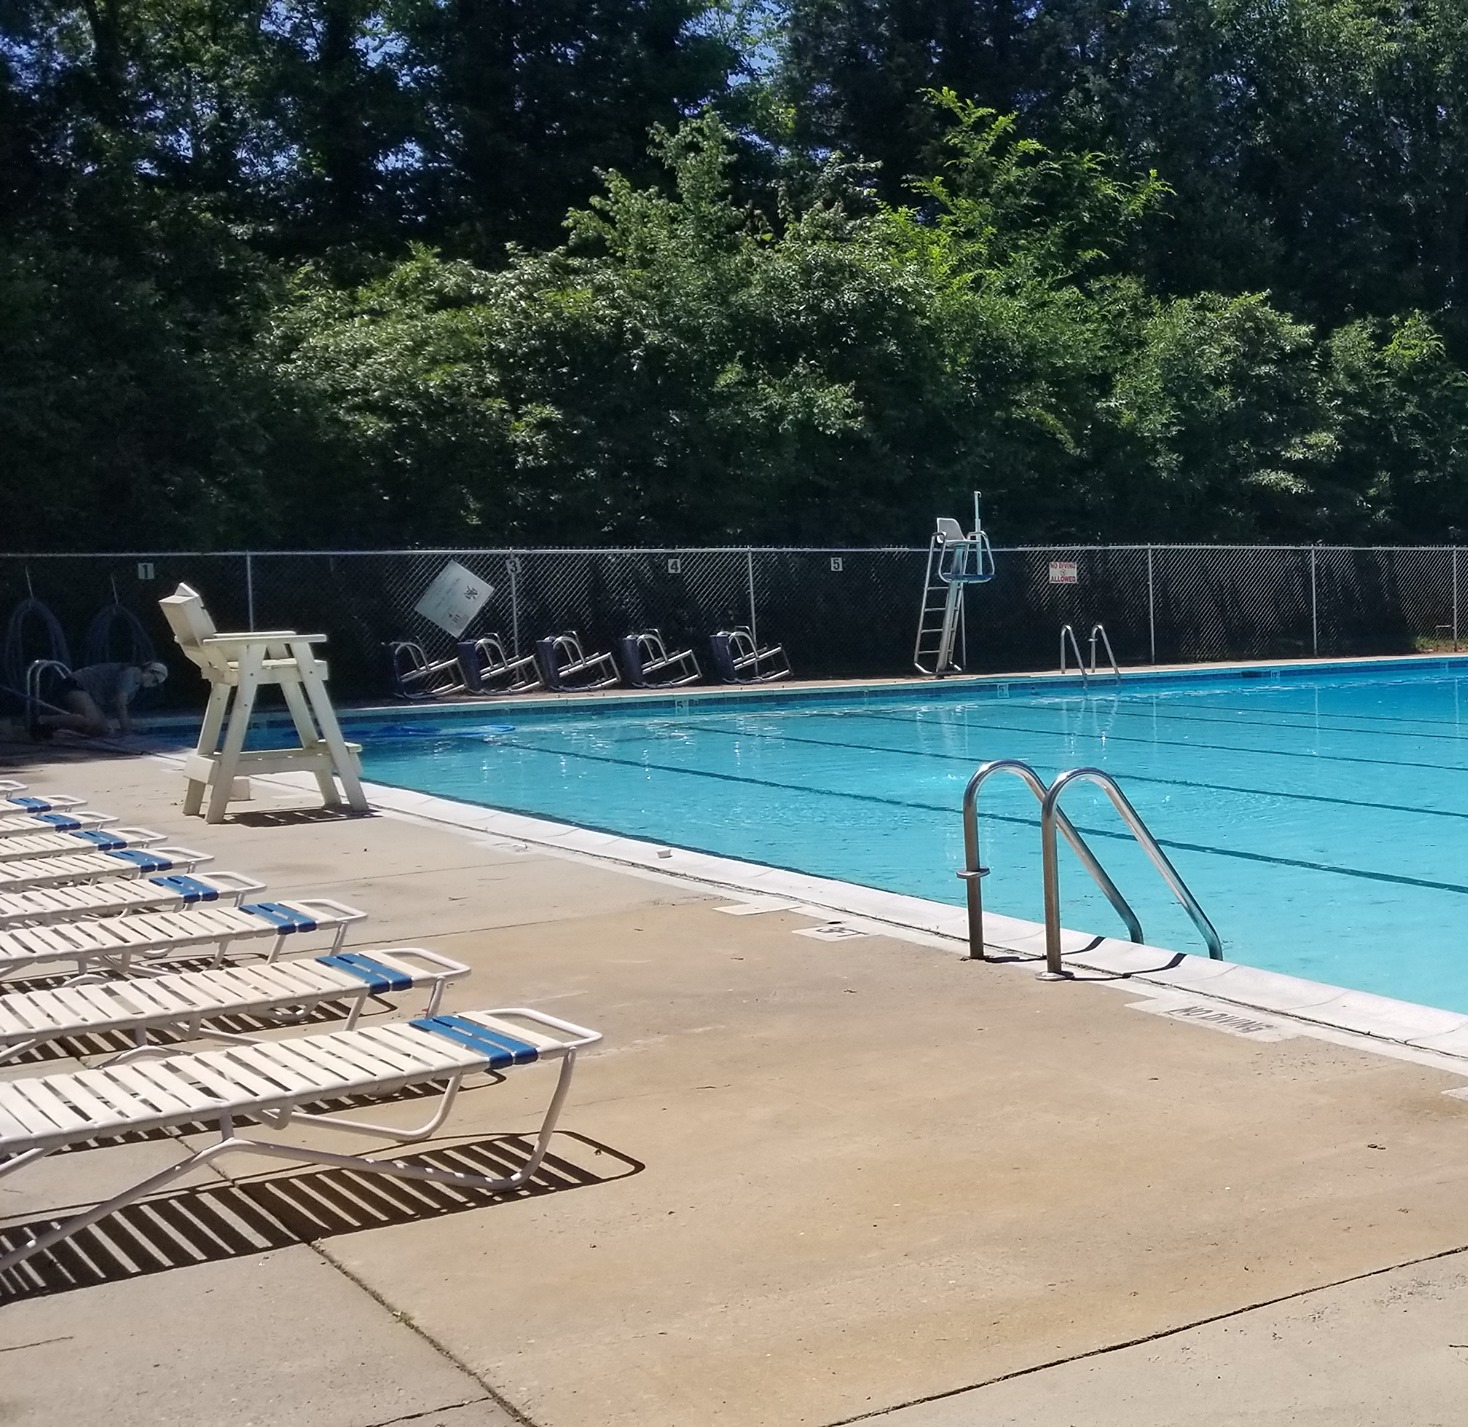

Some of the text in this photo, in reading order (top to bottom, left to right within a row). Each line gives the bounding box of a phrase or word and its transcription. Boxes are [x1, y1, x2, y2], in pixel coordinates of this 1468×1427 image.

[509, 560, 518, 573] 3
[670, 560, 679, 573] 4
[833, 558, 841, 570] 5
